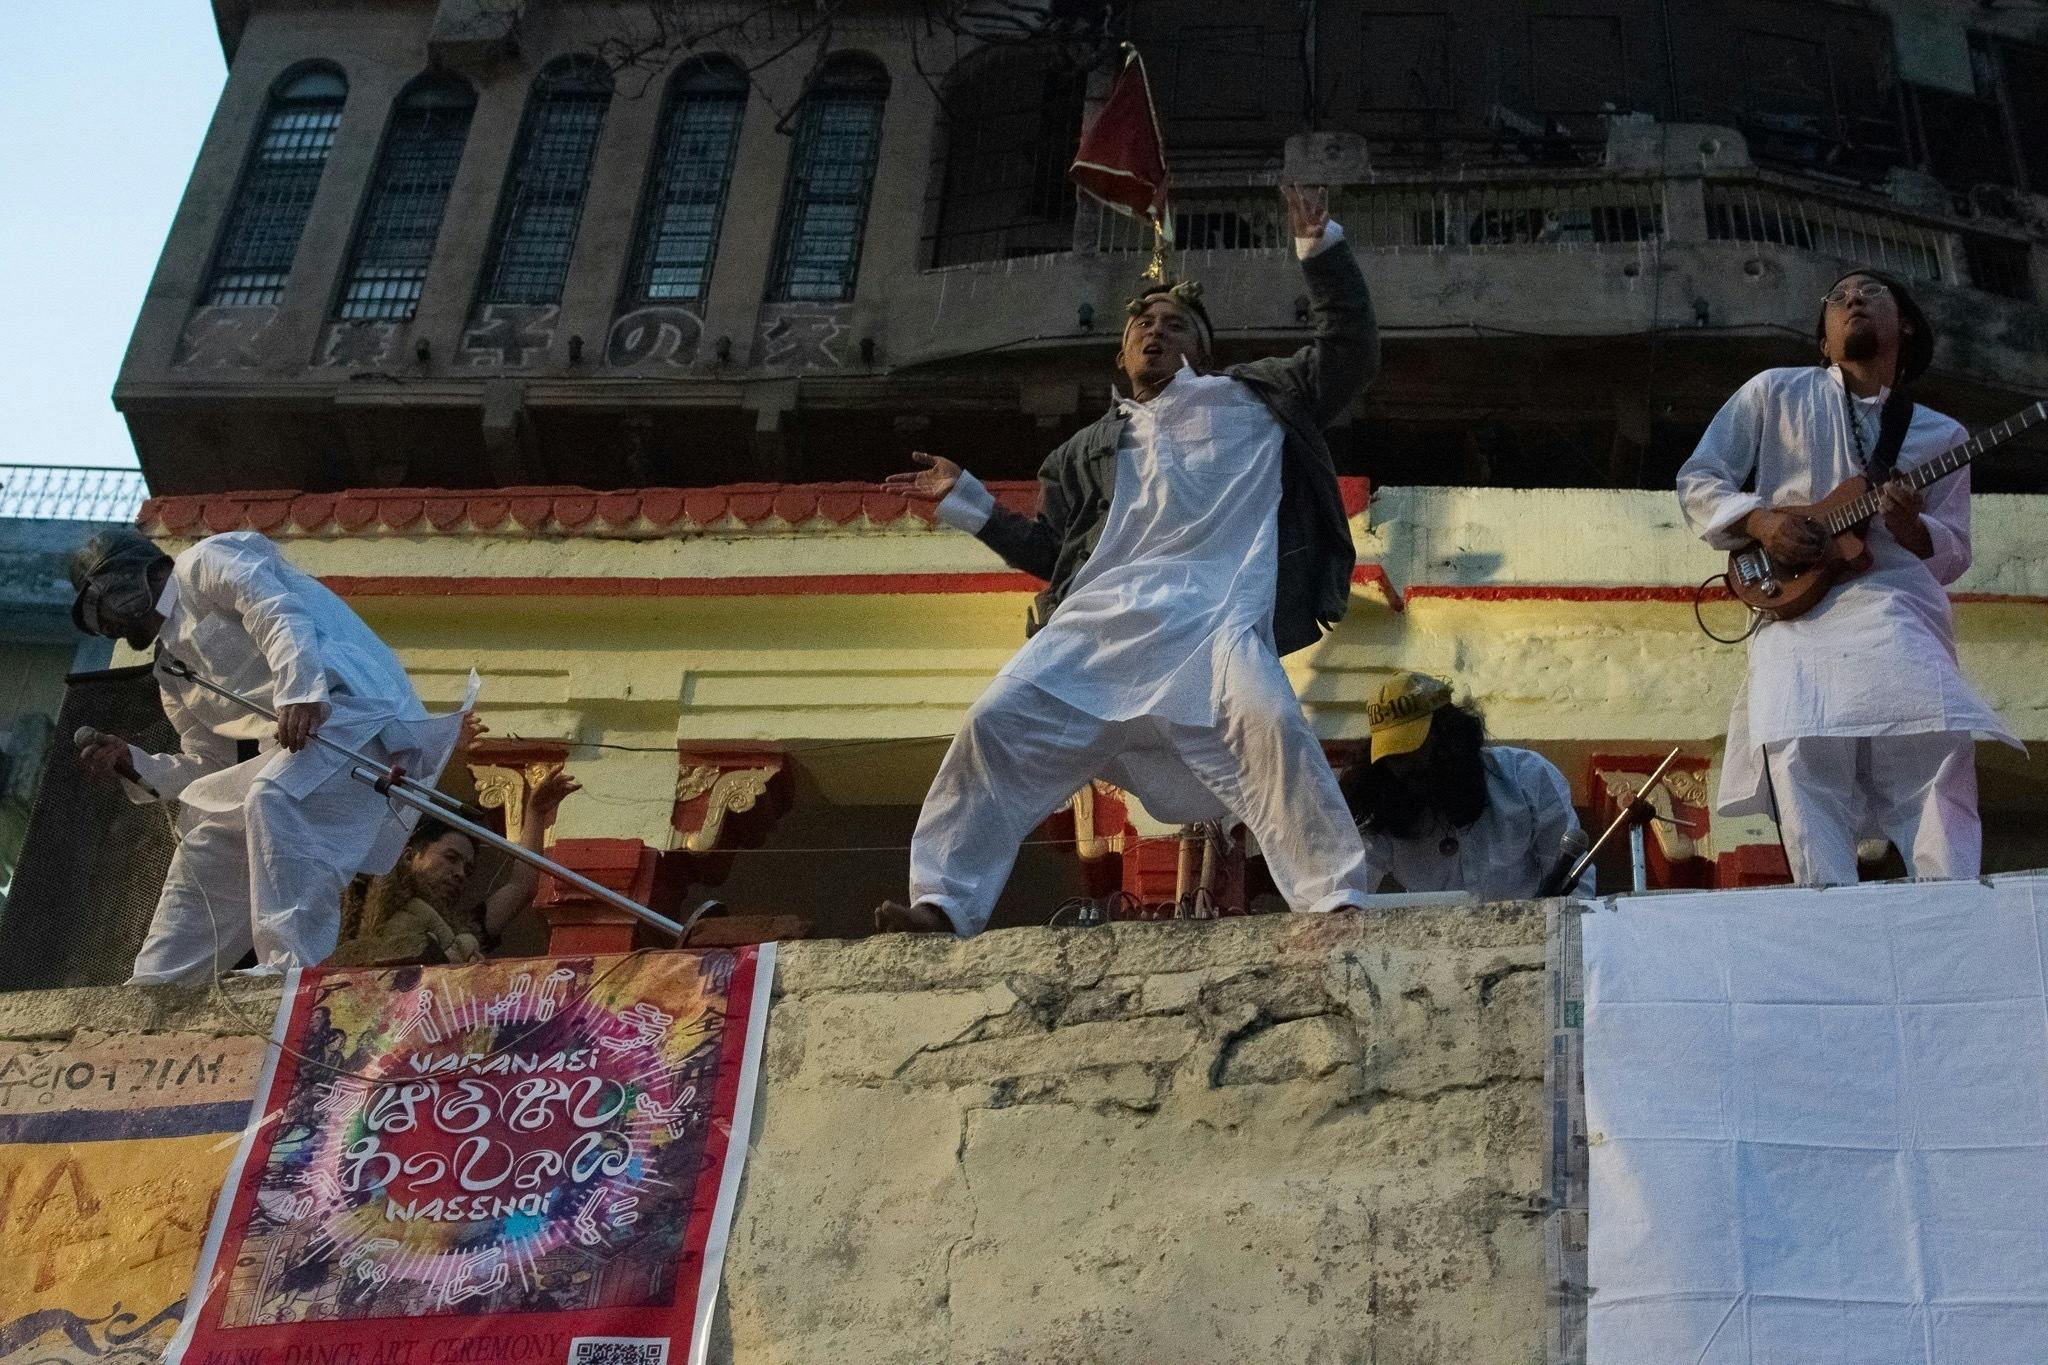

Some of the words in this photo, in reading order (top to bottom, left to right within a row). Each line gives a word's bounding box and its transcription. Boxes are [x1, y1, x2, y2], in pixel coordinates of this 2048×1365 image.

[409, 1049, 600, 1075] VARANASI
[386, 1192, 552, 1223] WASSHOI
[284, 1341, 363, 1365] DANCE
[371, 1339, 420, 1365] ART
[430, 1332, 563, 1364] CEREMONY
